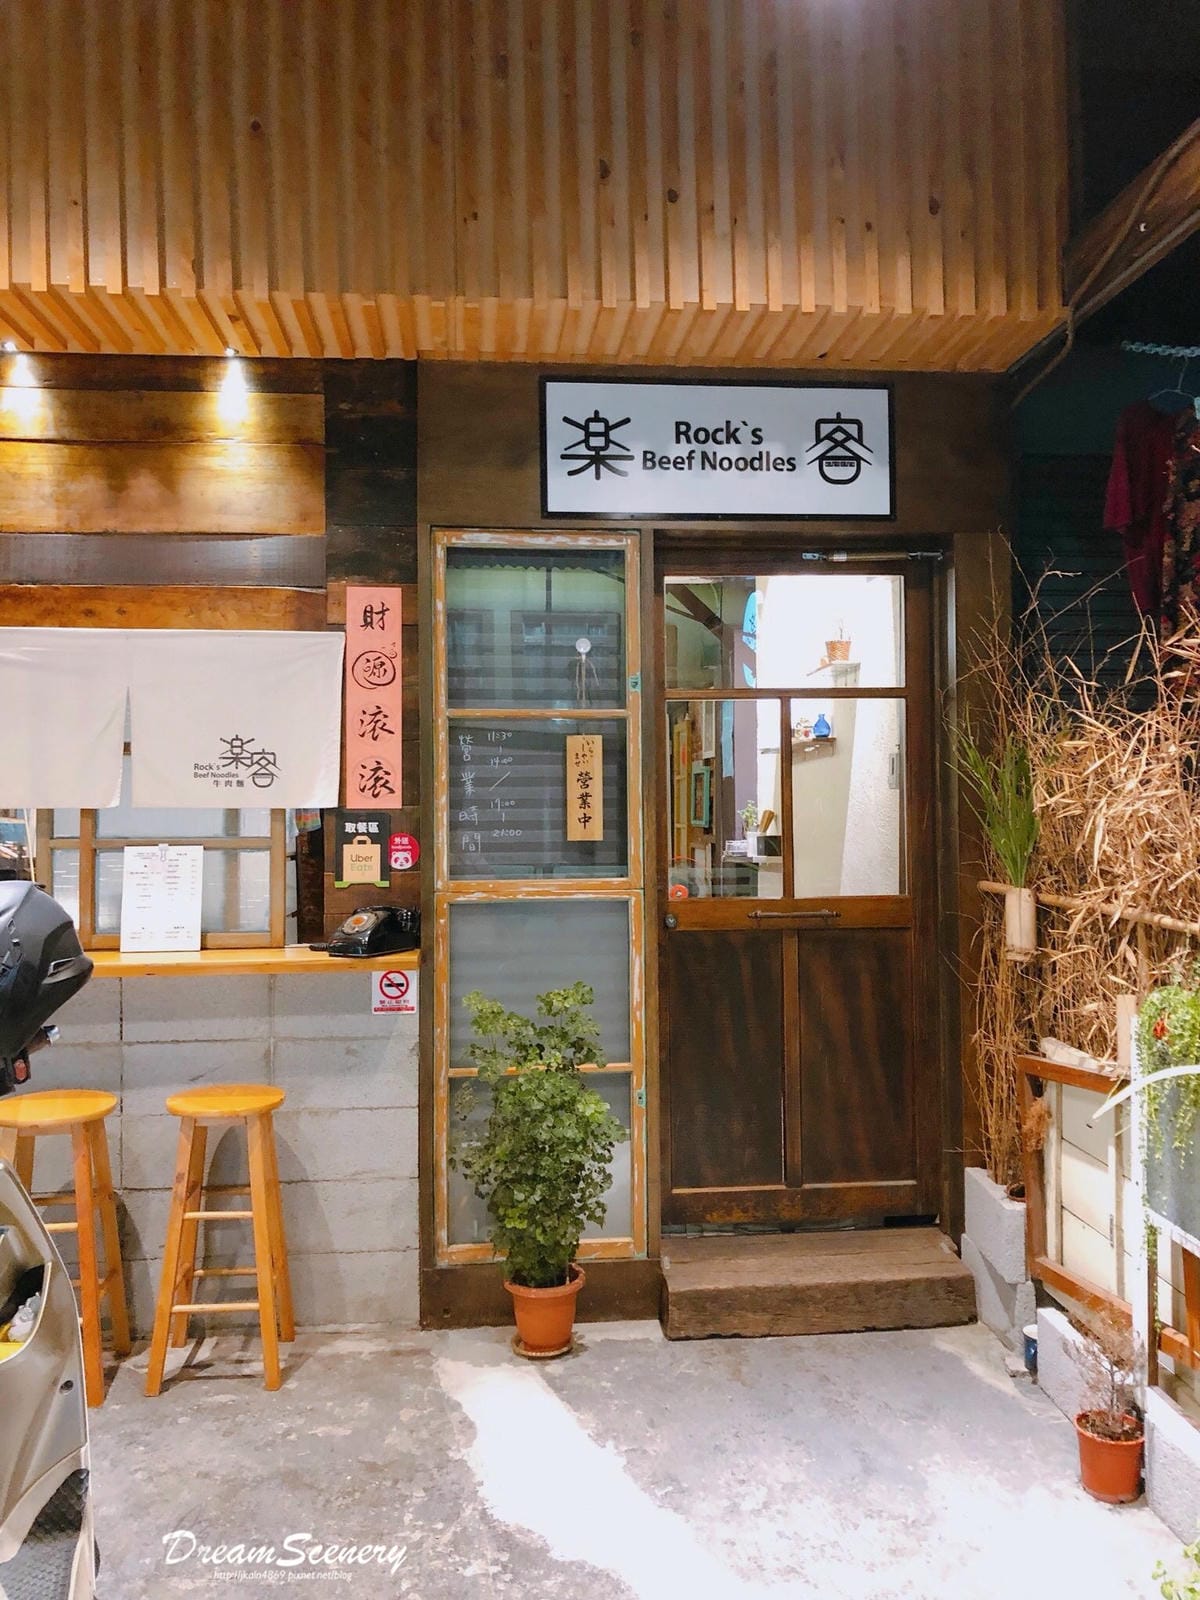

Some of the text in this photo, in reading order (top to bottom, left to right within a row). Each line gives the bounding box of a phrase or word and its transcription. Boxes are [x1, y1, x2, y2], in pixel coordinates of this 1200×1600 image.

[642, 450, 797, 473] Beef Noodles
[193, 771, 240, 779] Beef Noodles
[350, 853, 373, 863] Uber
